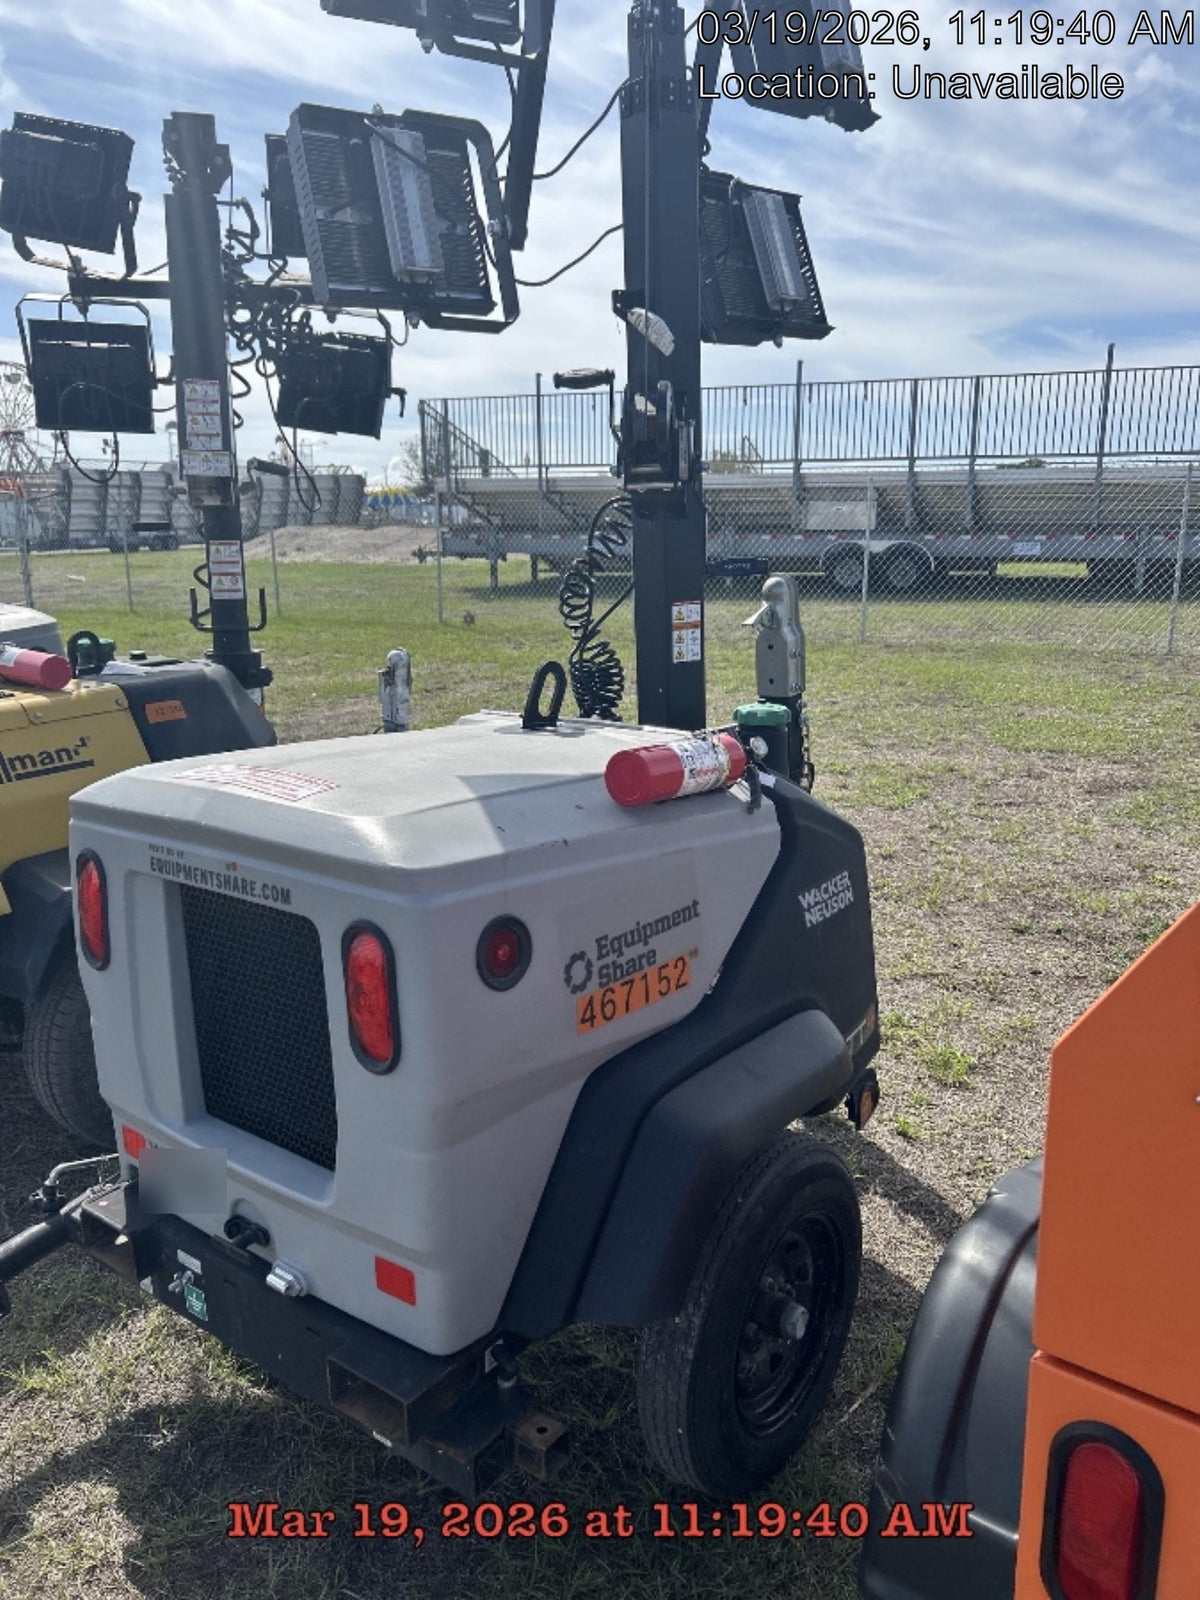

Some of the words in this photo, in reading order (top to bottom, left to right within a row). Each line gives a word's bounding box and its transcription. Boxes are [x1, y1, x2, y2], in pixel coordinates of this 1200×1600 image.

[150, 856, 292, 906] EQUIPMENTSHARE.COM
[798, 870, 851, 909] WACKER
[595, 899, 700, 961] Equipment
[804, 886, 854, 928] NEUSON
[598, 949, 657, 988] Share
[579, 956, 689, 1028] 467152
